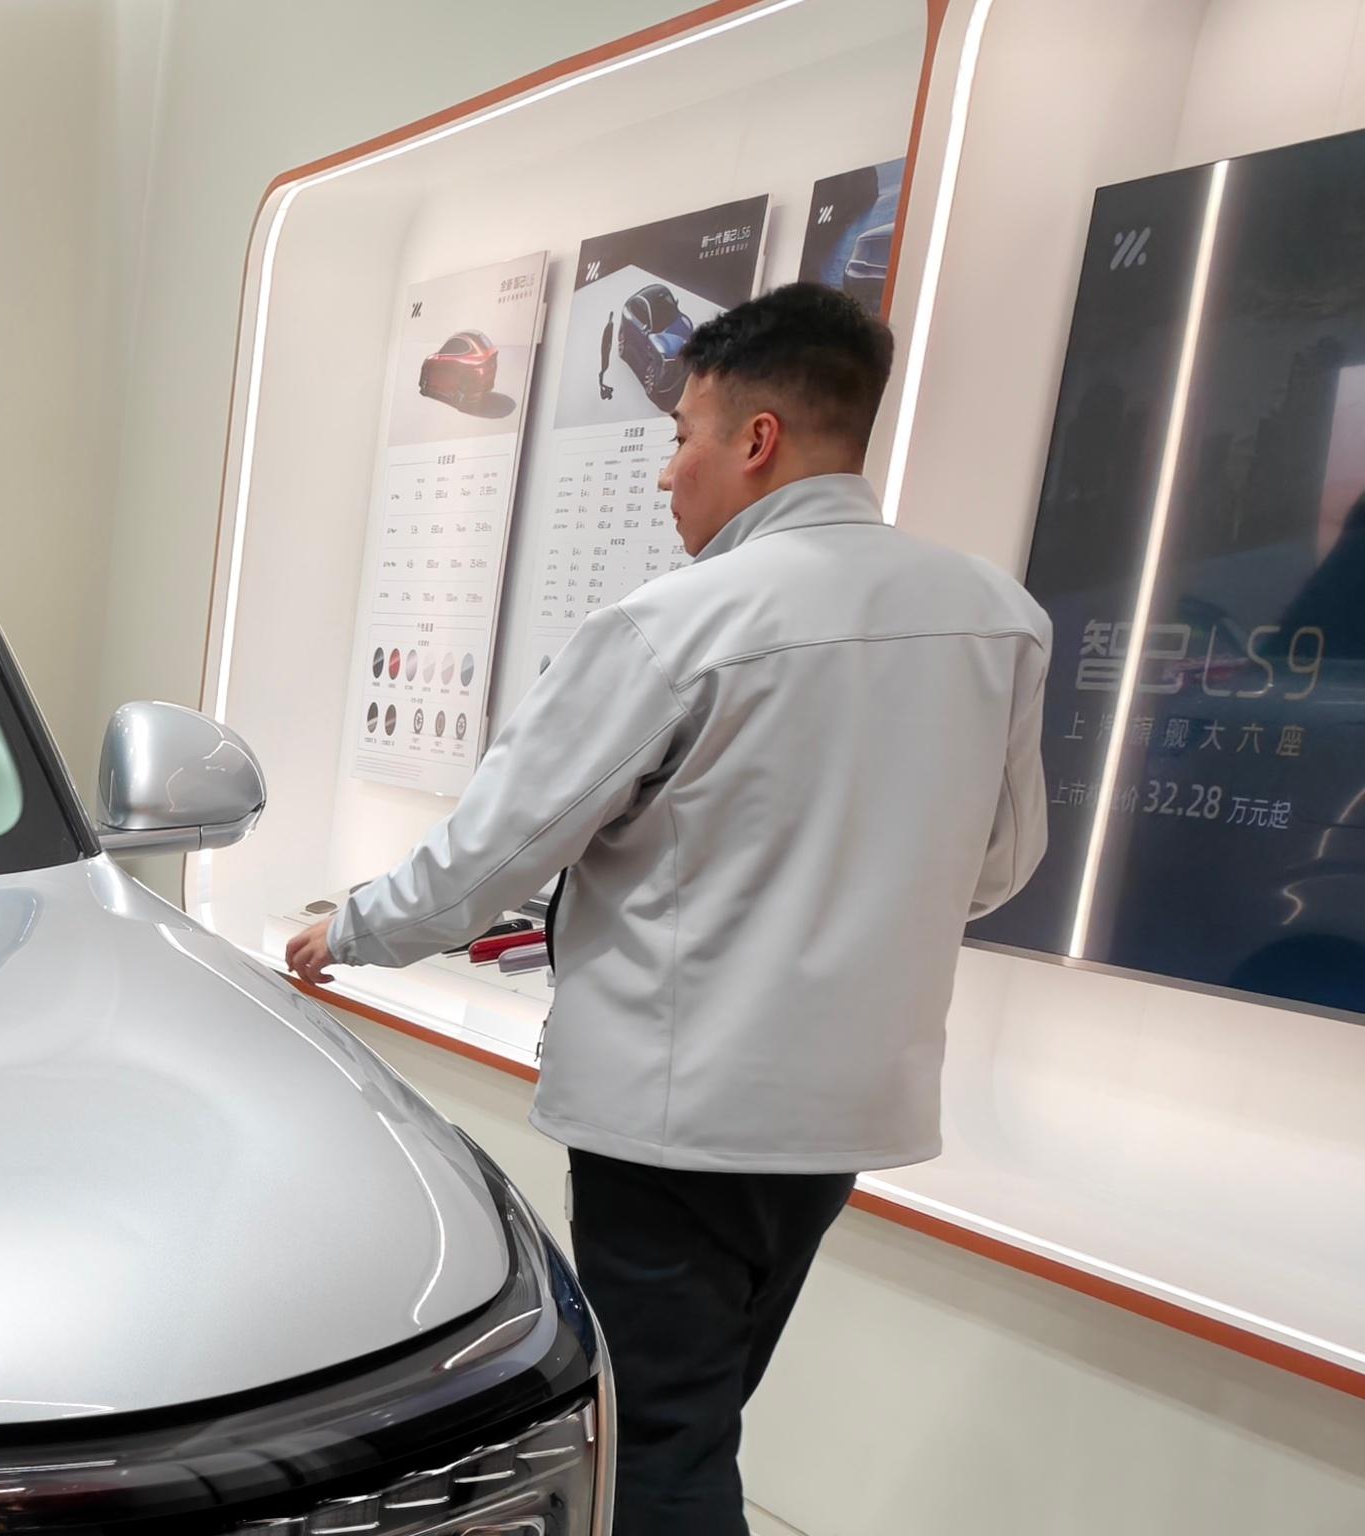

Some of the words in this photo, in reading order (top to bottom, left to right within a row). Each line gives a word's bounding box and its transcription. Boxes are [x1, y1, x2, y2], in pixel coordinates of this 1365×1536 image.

[1143, 780, 1223, 819] 32.28
[1225, 795, 1292, 830] 万元起
